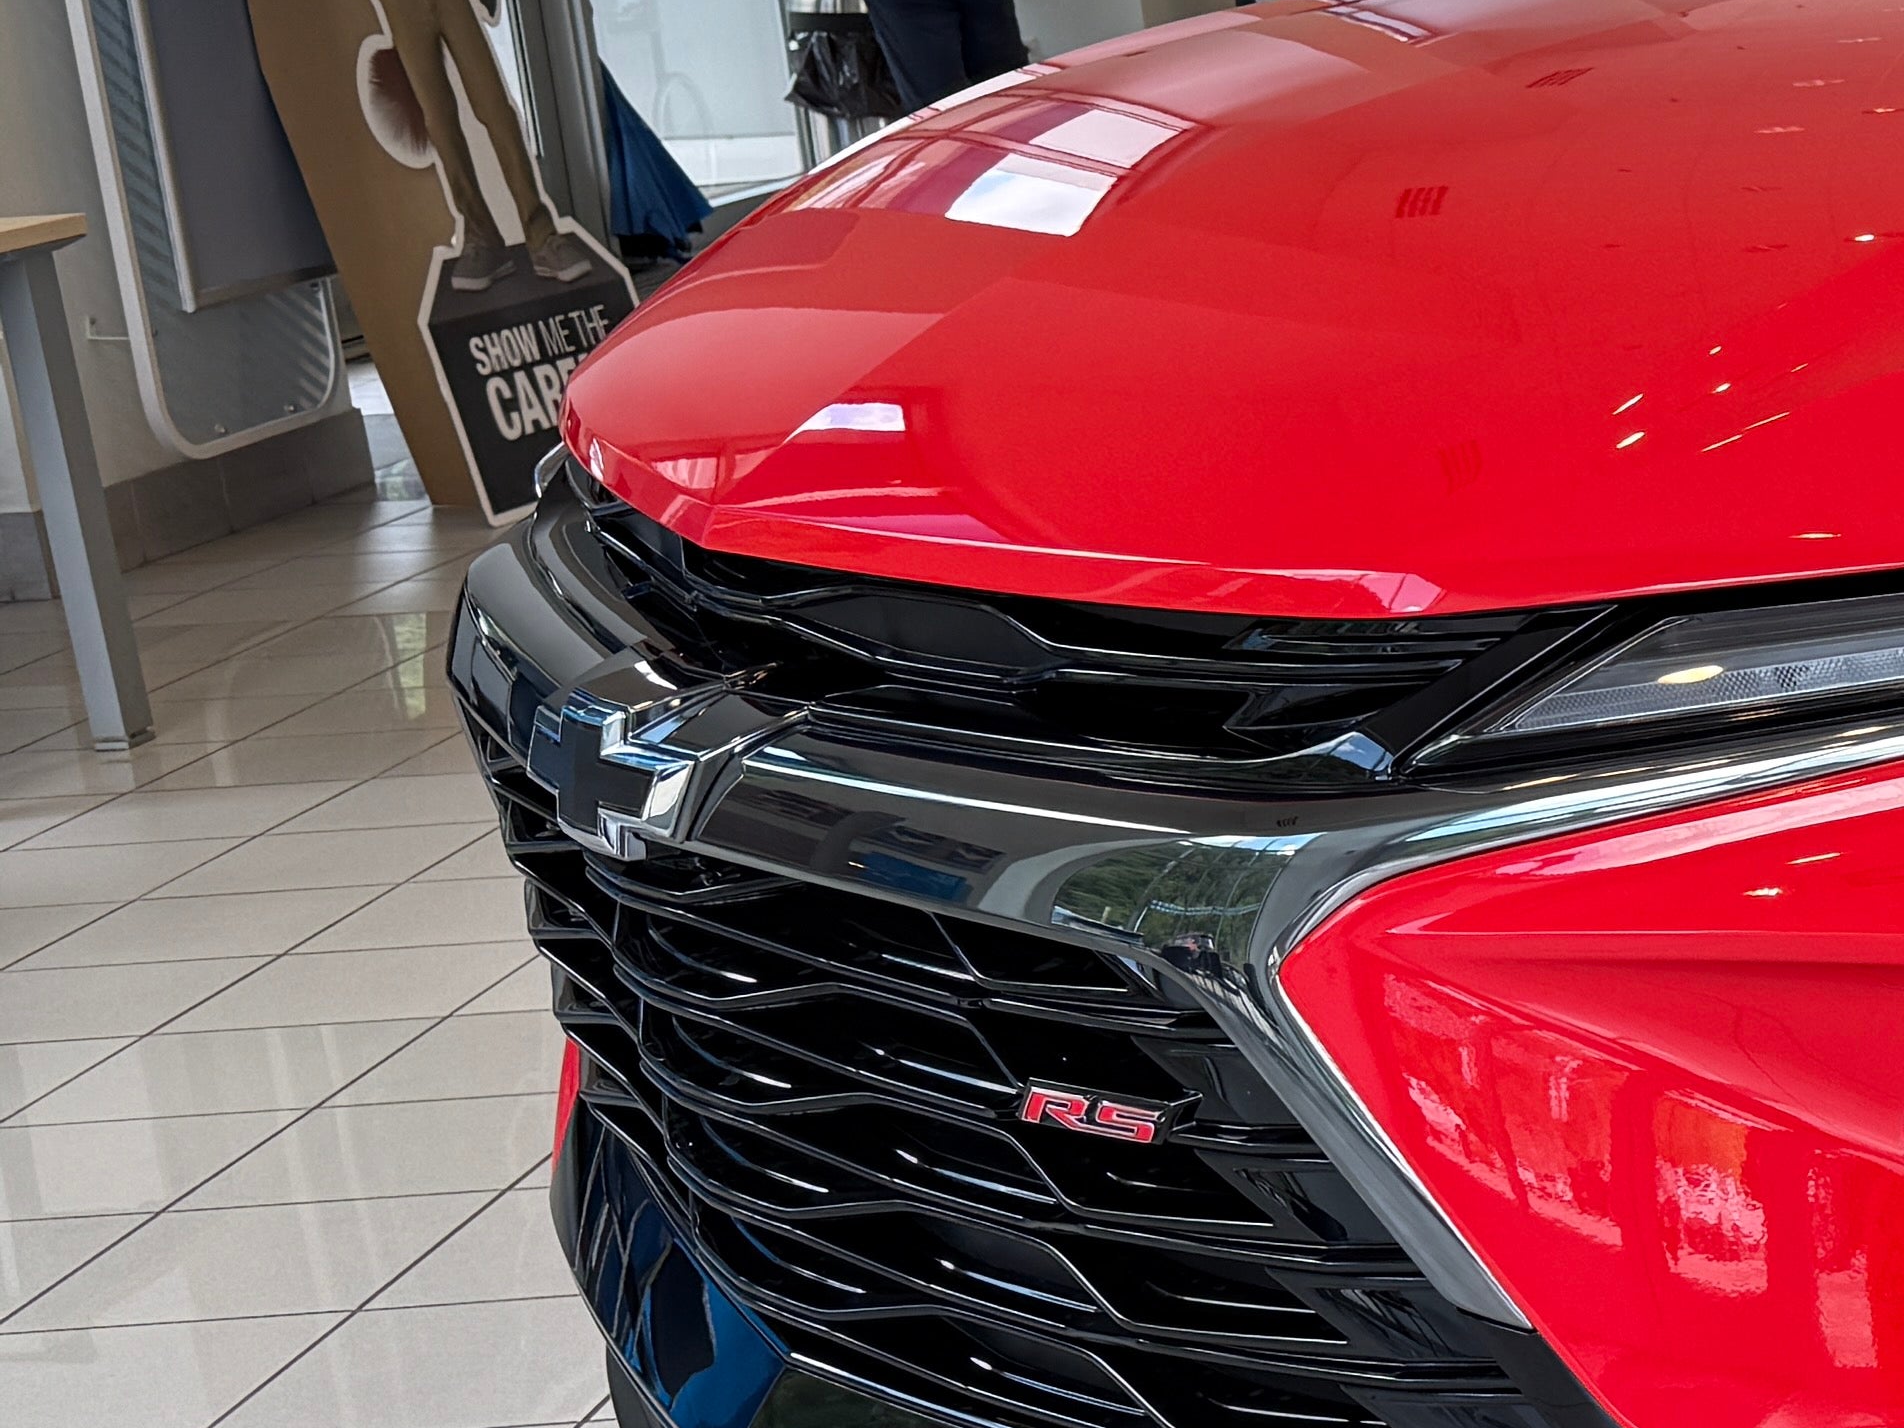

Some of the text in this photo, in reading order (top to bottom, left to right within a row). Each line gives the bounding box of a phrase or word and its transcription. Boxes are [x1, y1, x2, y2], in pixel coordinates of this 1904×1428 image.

[469, 323, 541, 376] SHOW
[538, 313, 576, 357] ME
[1019, 1086, 1156, 1143] RS
